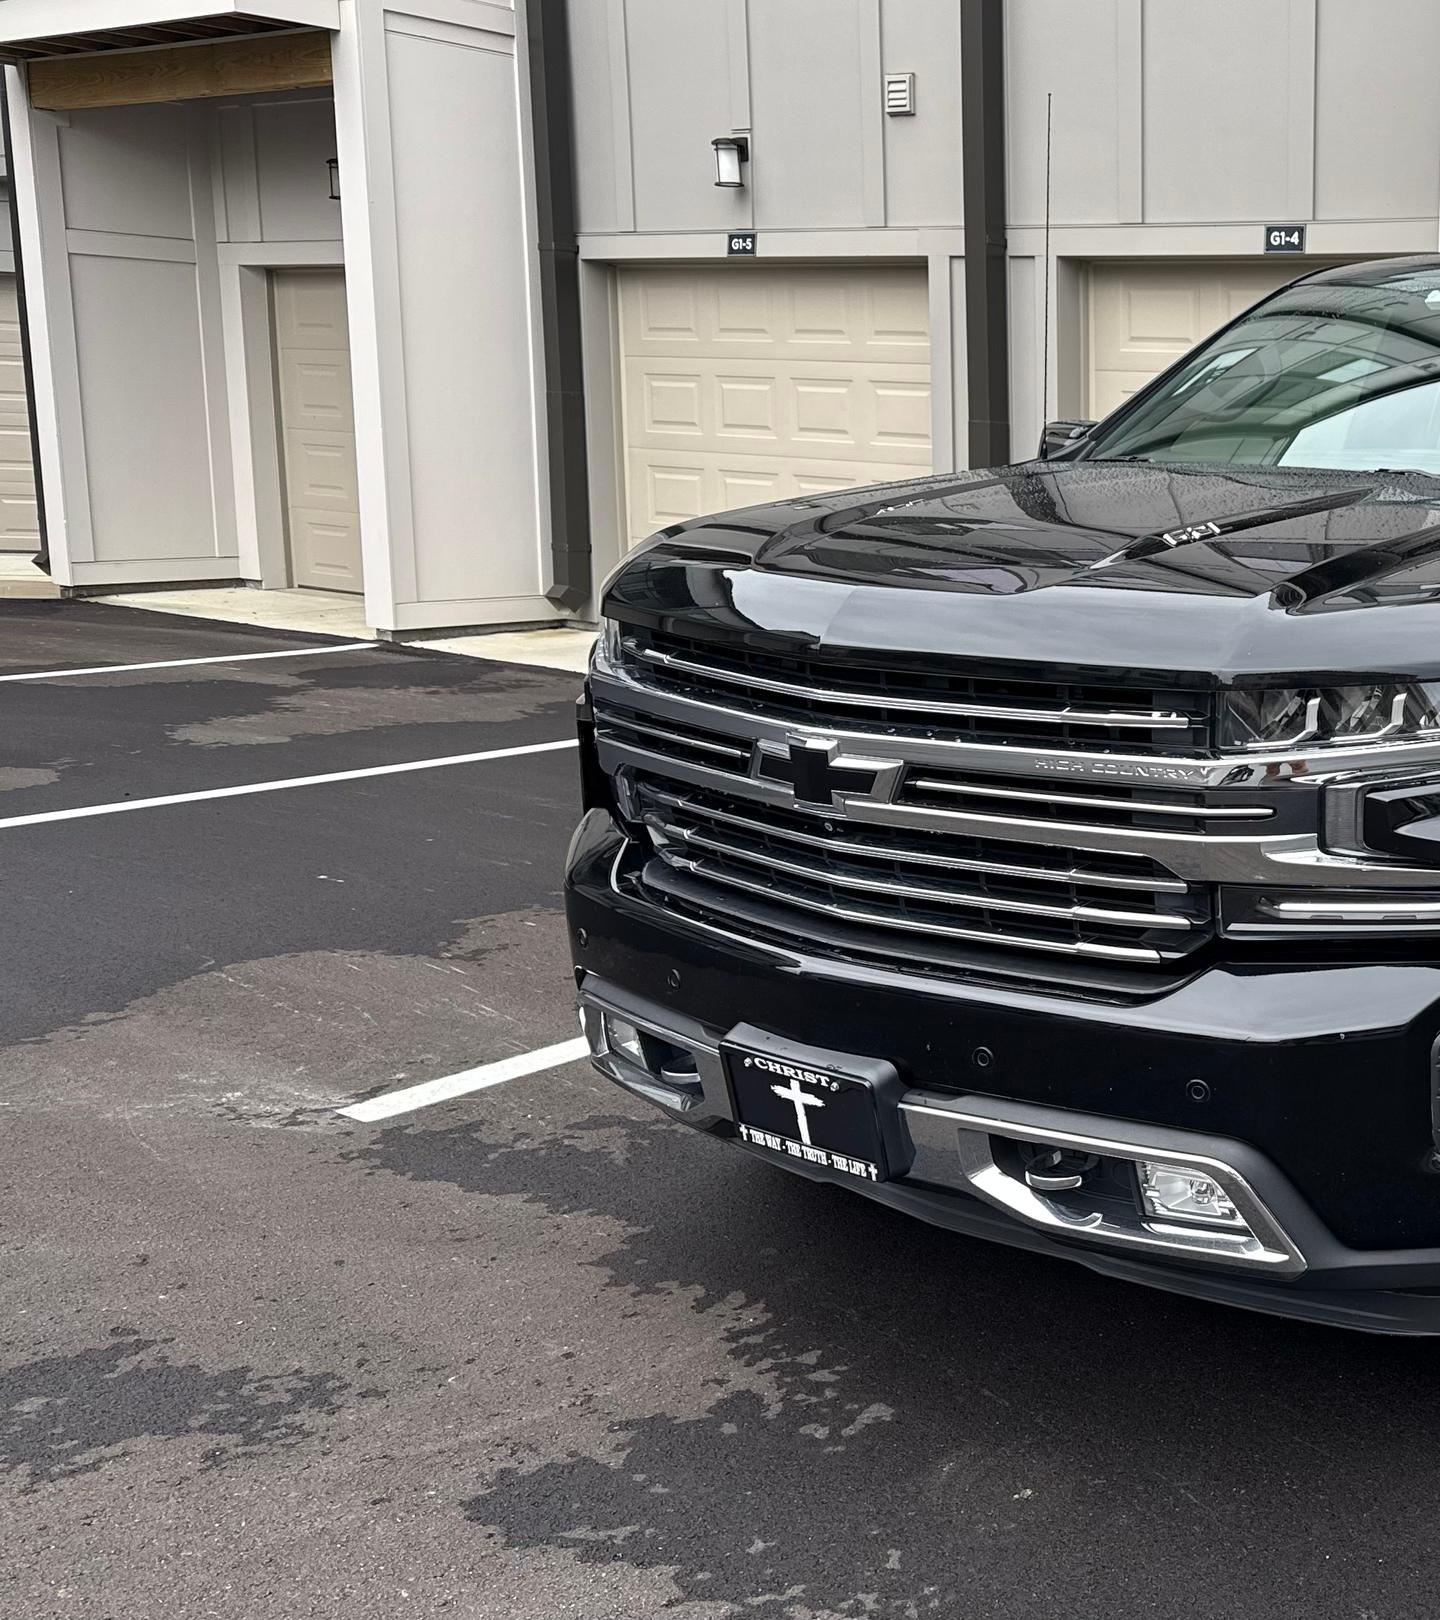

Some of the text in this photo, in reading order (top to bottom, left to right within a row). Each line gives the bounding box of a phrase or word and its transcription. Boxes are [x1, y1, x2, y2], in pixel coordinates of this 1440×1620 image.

[731, 238, 752, 250] G1-5
[1270, 231, 1300, 246] G1-4
[754, 1057, 830, 1087] CHRIST
[750, 1130, 867, 1176] THE WAY THE TRUTH THE LIFE
